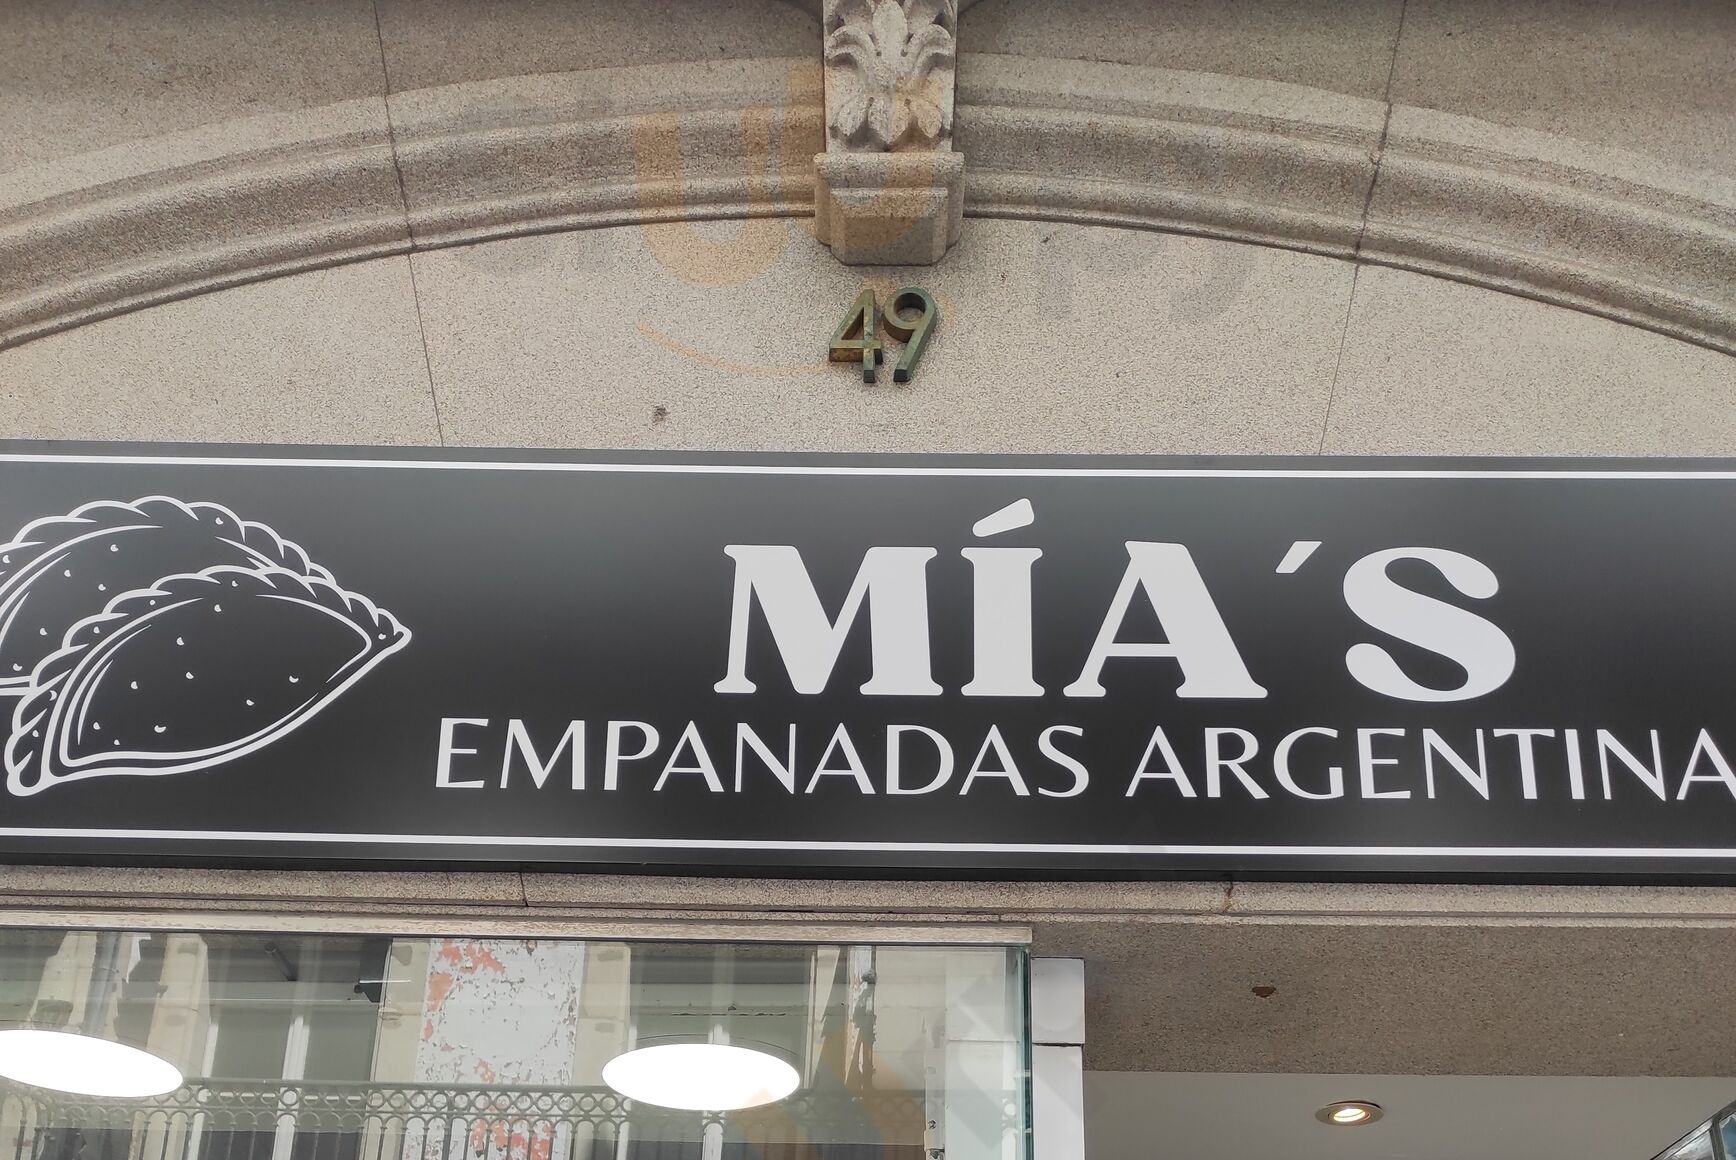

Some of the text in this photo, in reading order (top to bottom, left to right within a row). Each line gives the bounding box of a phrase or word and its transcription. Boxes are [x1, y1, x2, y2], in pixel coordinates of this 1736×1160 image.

[829, 286, 937, 383] 49
[436, 718, 1736, 801] EMPANADAS ARGENTINA
